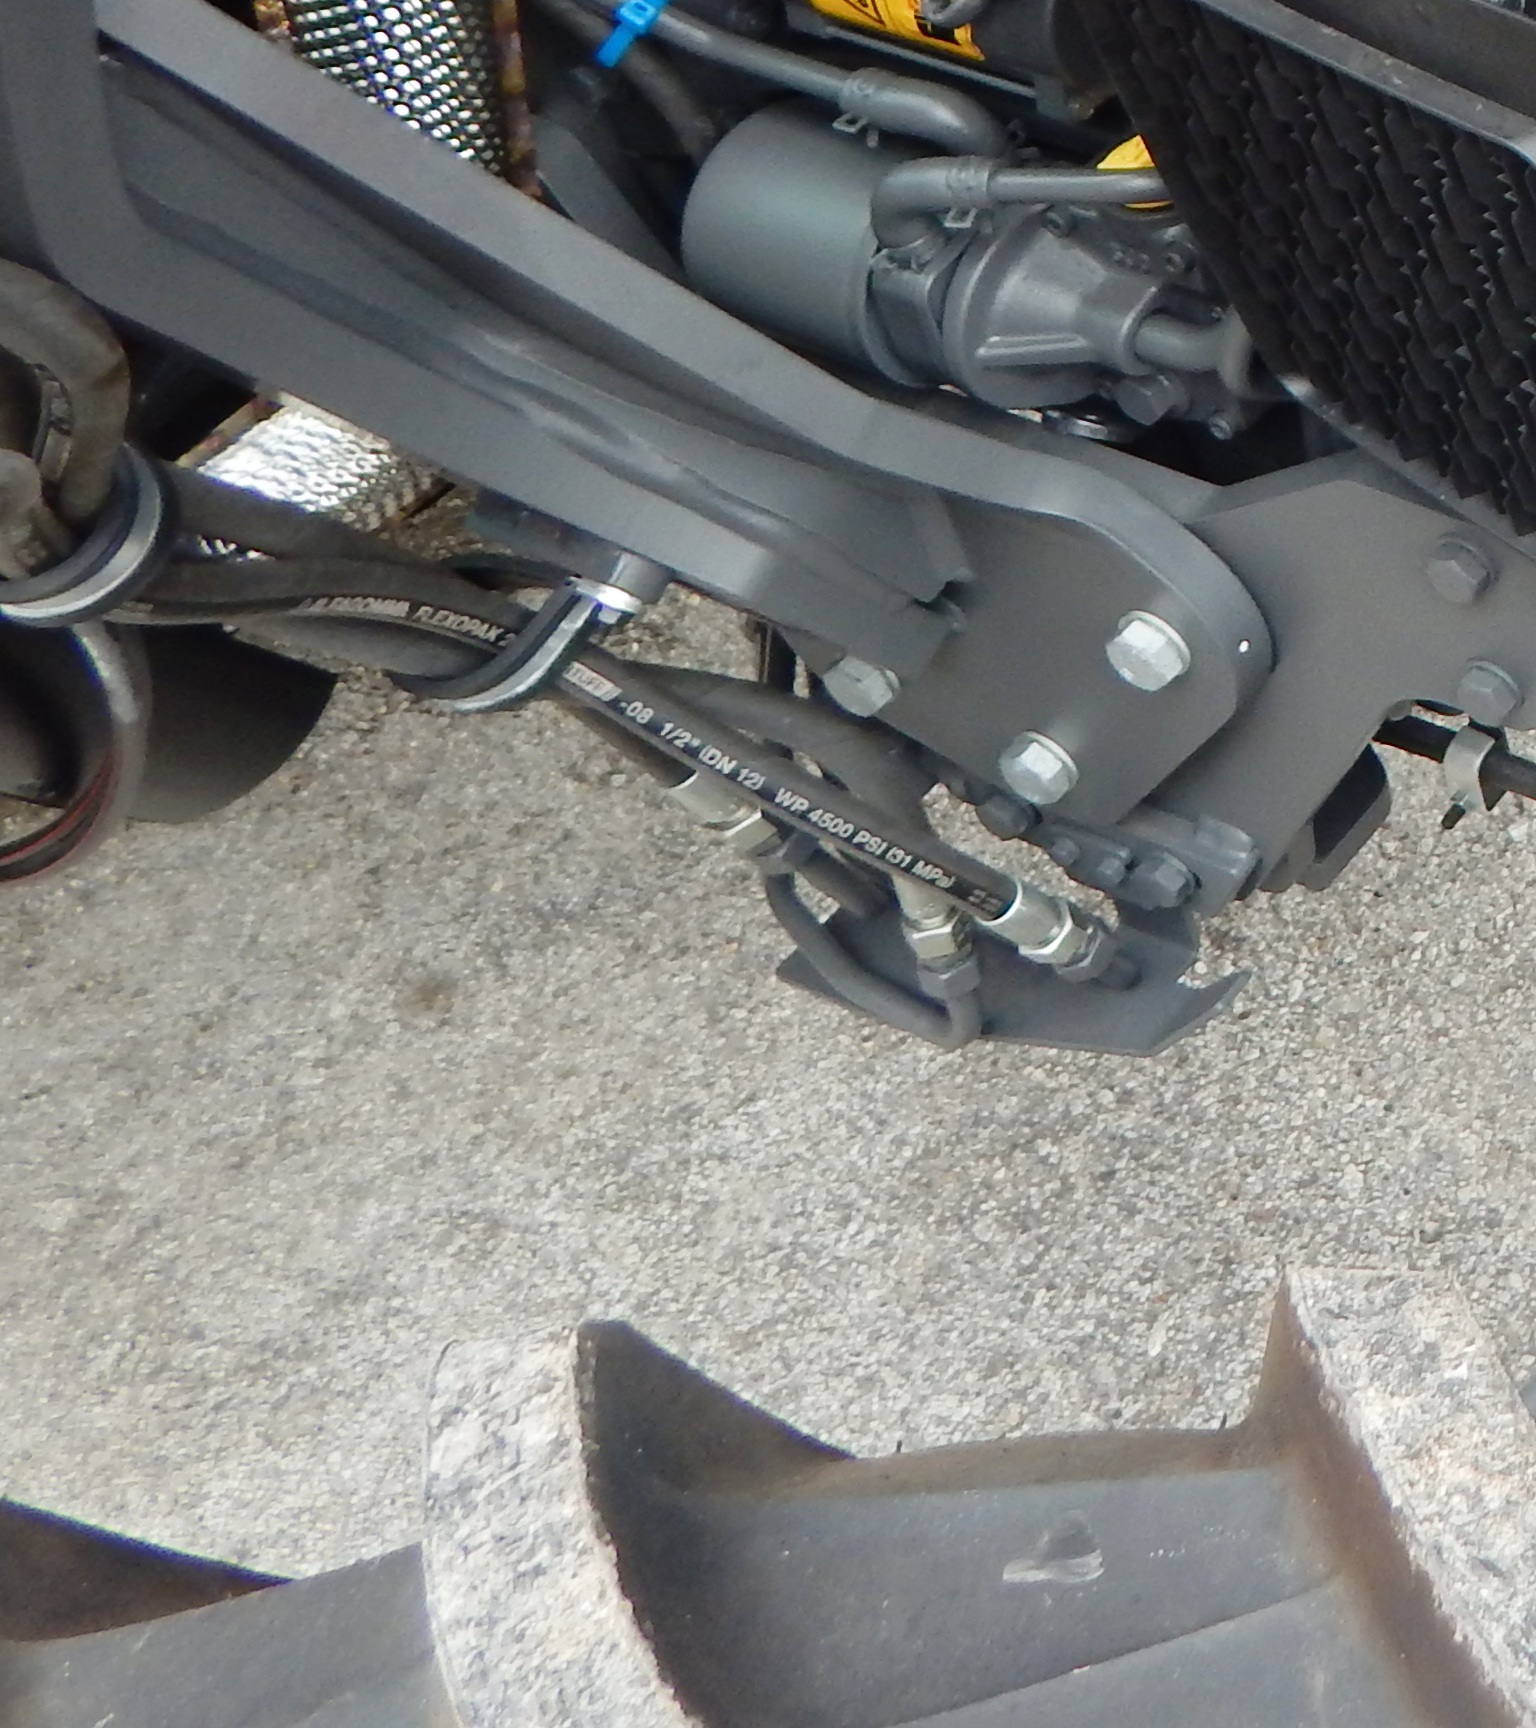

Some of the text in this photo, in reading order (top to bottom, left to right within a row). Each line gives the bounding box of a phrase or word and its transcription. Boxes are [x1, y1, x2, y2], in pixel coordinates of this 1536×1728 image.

[659, 721, 701, 748] 1/2"
[699, 744, 738, 775] (DN
[737, 767, 766, 791] 12)
[774, 786, 810, 813] WP
[807, 808, 855, 839] 4500
[852, 829, 889, 857] PSI
[885, 845, 913, 868] (31
